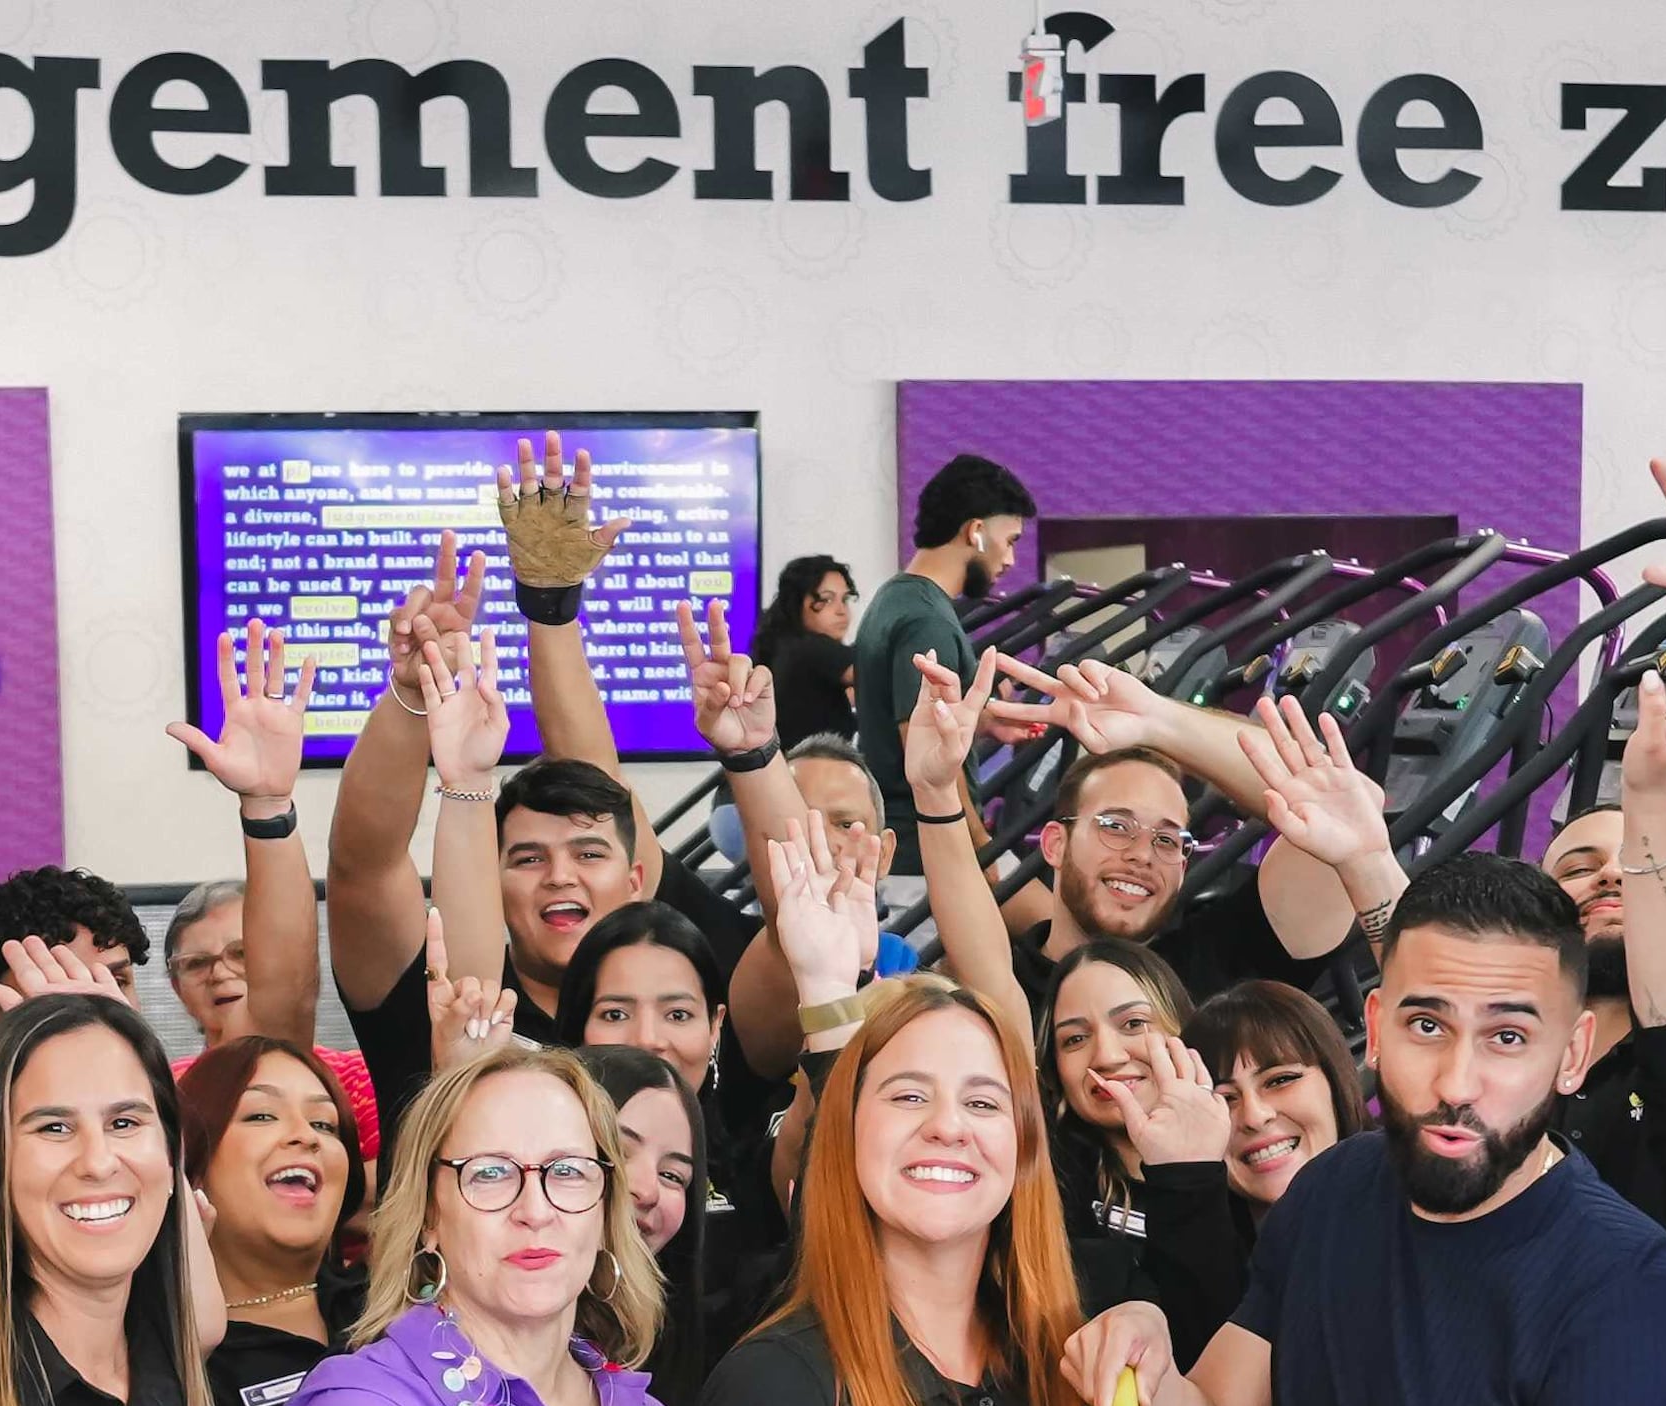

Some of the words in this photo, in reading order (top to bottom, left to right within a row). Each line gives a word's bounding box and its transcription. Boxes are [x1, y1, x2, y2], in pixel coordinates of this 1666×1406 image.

[1006, 11, 1485, 208] free
[223, 466, 250, 478] we
[258, 463, 277, 478] at
[397, 462, 417, 476] to
[224, 485, 280, 500] which
[284, 488, 354, 503] anyone,
[359, 485, 393, 500] and
[397, 487, 422, 499] we
[590, 483, 613, 499] be
[225, 511, 237, 524] a
[244, 508, 318, 525] diverse,
[602, 506, 668, 524] lasting,
[676, 506, 729, 520] active
[225, 531, 301, 550] lifestyle
[305, 534, 338, 546] can
[341, 531, 365, 546] be
[367, 530, 417, 545] built.
[623, 532, 682, 543] means
[685, 529, 703, 543] to
[707, 532, 730, 543] an
[226, 554, 266, 572] end;
[271, 556, 301, 569] not
[306, 557, 319, 569] a
[323, 553, 378, 569] brand
[383, 556, 434, 568] name
[638, 554, 650, 566] a
[655, 551, 690, 566] tool
[694, 551, 730, 566] that
[226, 581, 260, 593] can
[267, 577, 291, 593] be
[298, 576, 343, 592] used
[349, 576, 373, 595] by
[603, 574, 628, 589] all
[635, 574, 685, 588] about
[227, 604, 248, 616] as
[257, 604, 283, 616] we
[361, 599, 394, 614] and
[585, 600, 610, 612] we
[618, 596, 654, 611] will
[296, 623, 330, 638] this
[334, 623, 376, 640] safe,
[591, 619, 646, 634] where
[496, 646, 520, 658] we
[586, 642, 626, 656] here
[630, 643, 647, 656] to
[319, 670, 338, 682] to
[342, 668, 383, 682] kick
[614, 667, 640, 678] we
[644, 664, 687, 678] need
[308, 691, 347, 706] face
[350, 690, 371, 708] it,
[611, 690, 660, 701] same
